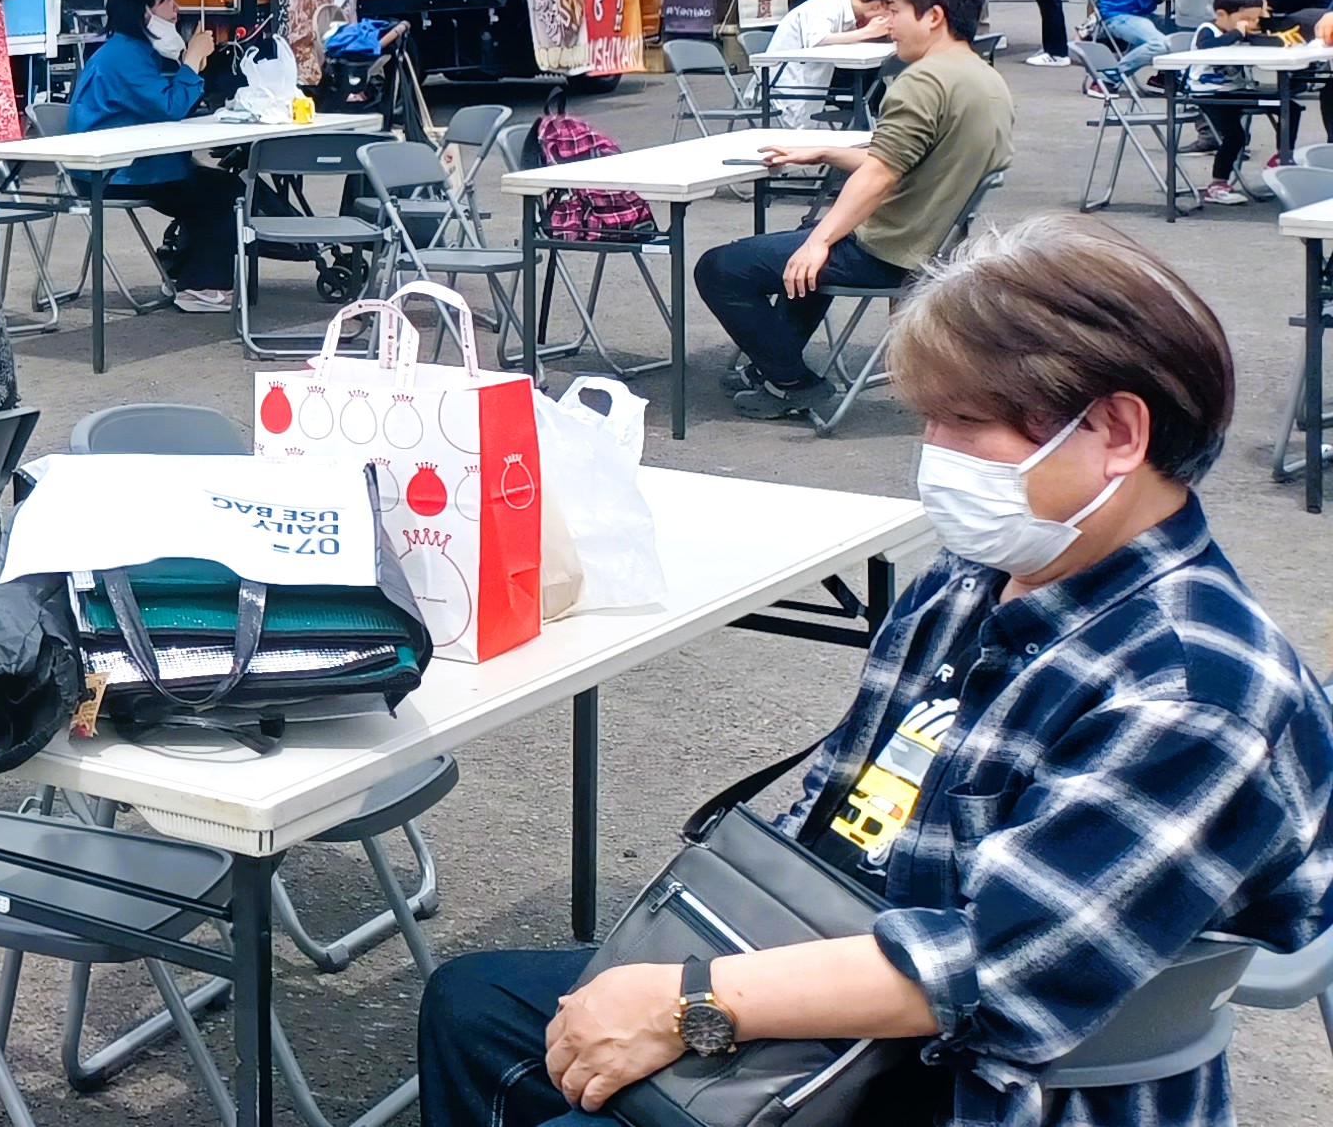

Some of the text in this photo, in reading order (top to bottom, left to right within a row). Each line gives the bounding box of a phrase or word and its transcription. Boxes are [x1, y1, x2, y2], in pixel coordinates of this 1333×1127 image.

[588, 35, 644, 72] USHIYAKI
[212, 496, 339, 523] USE BAG
[251, 519, 339, 536] DAILY
